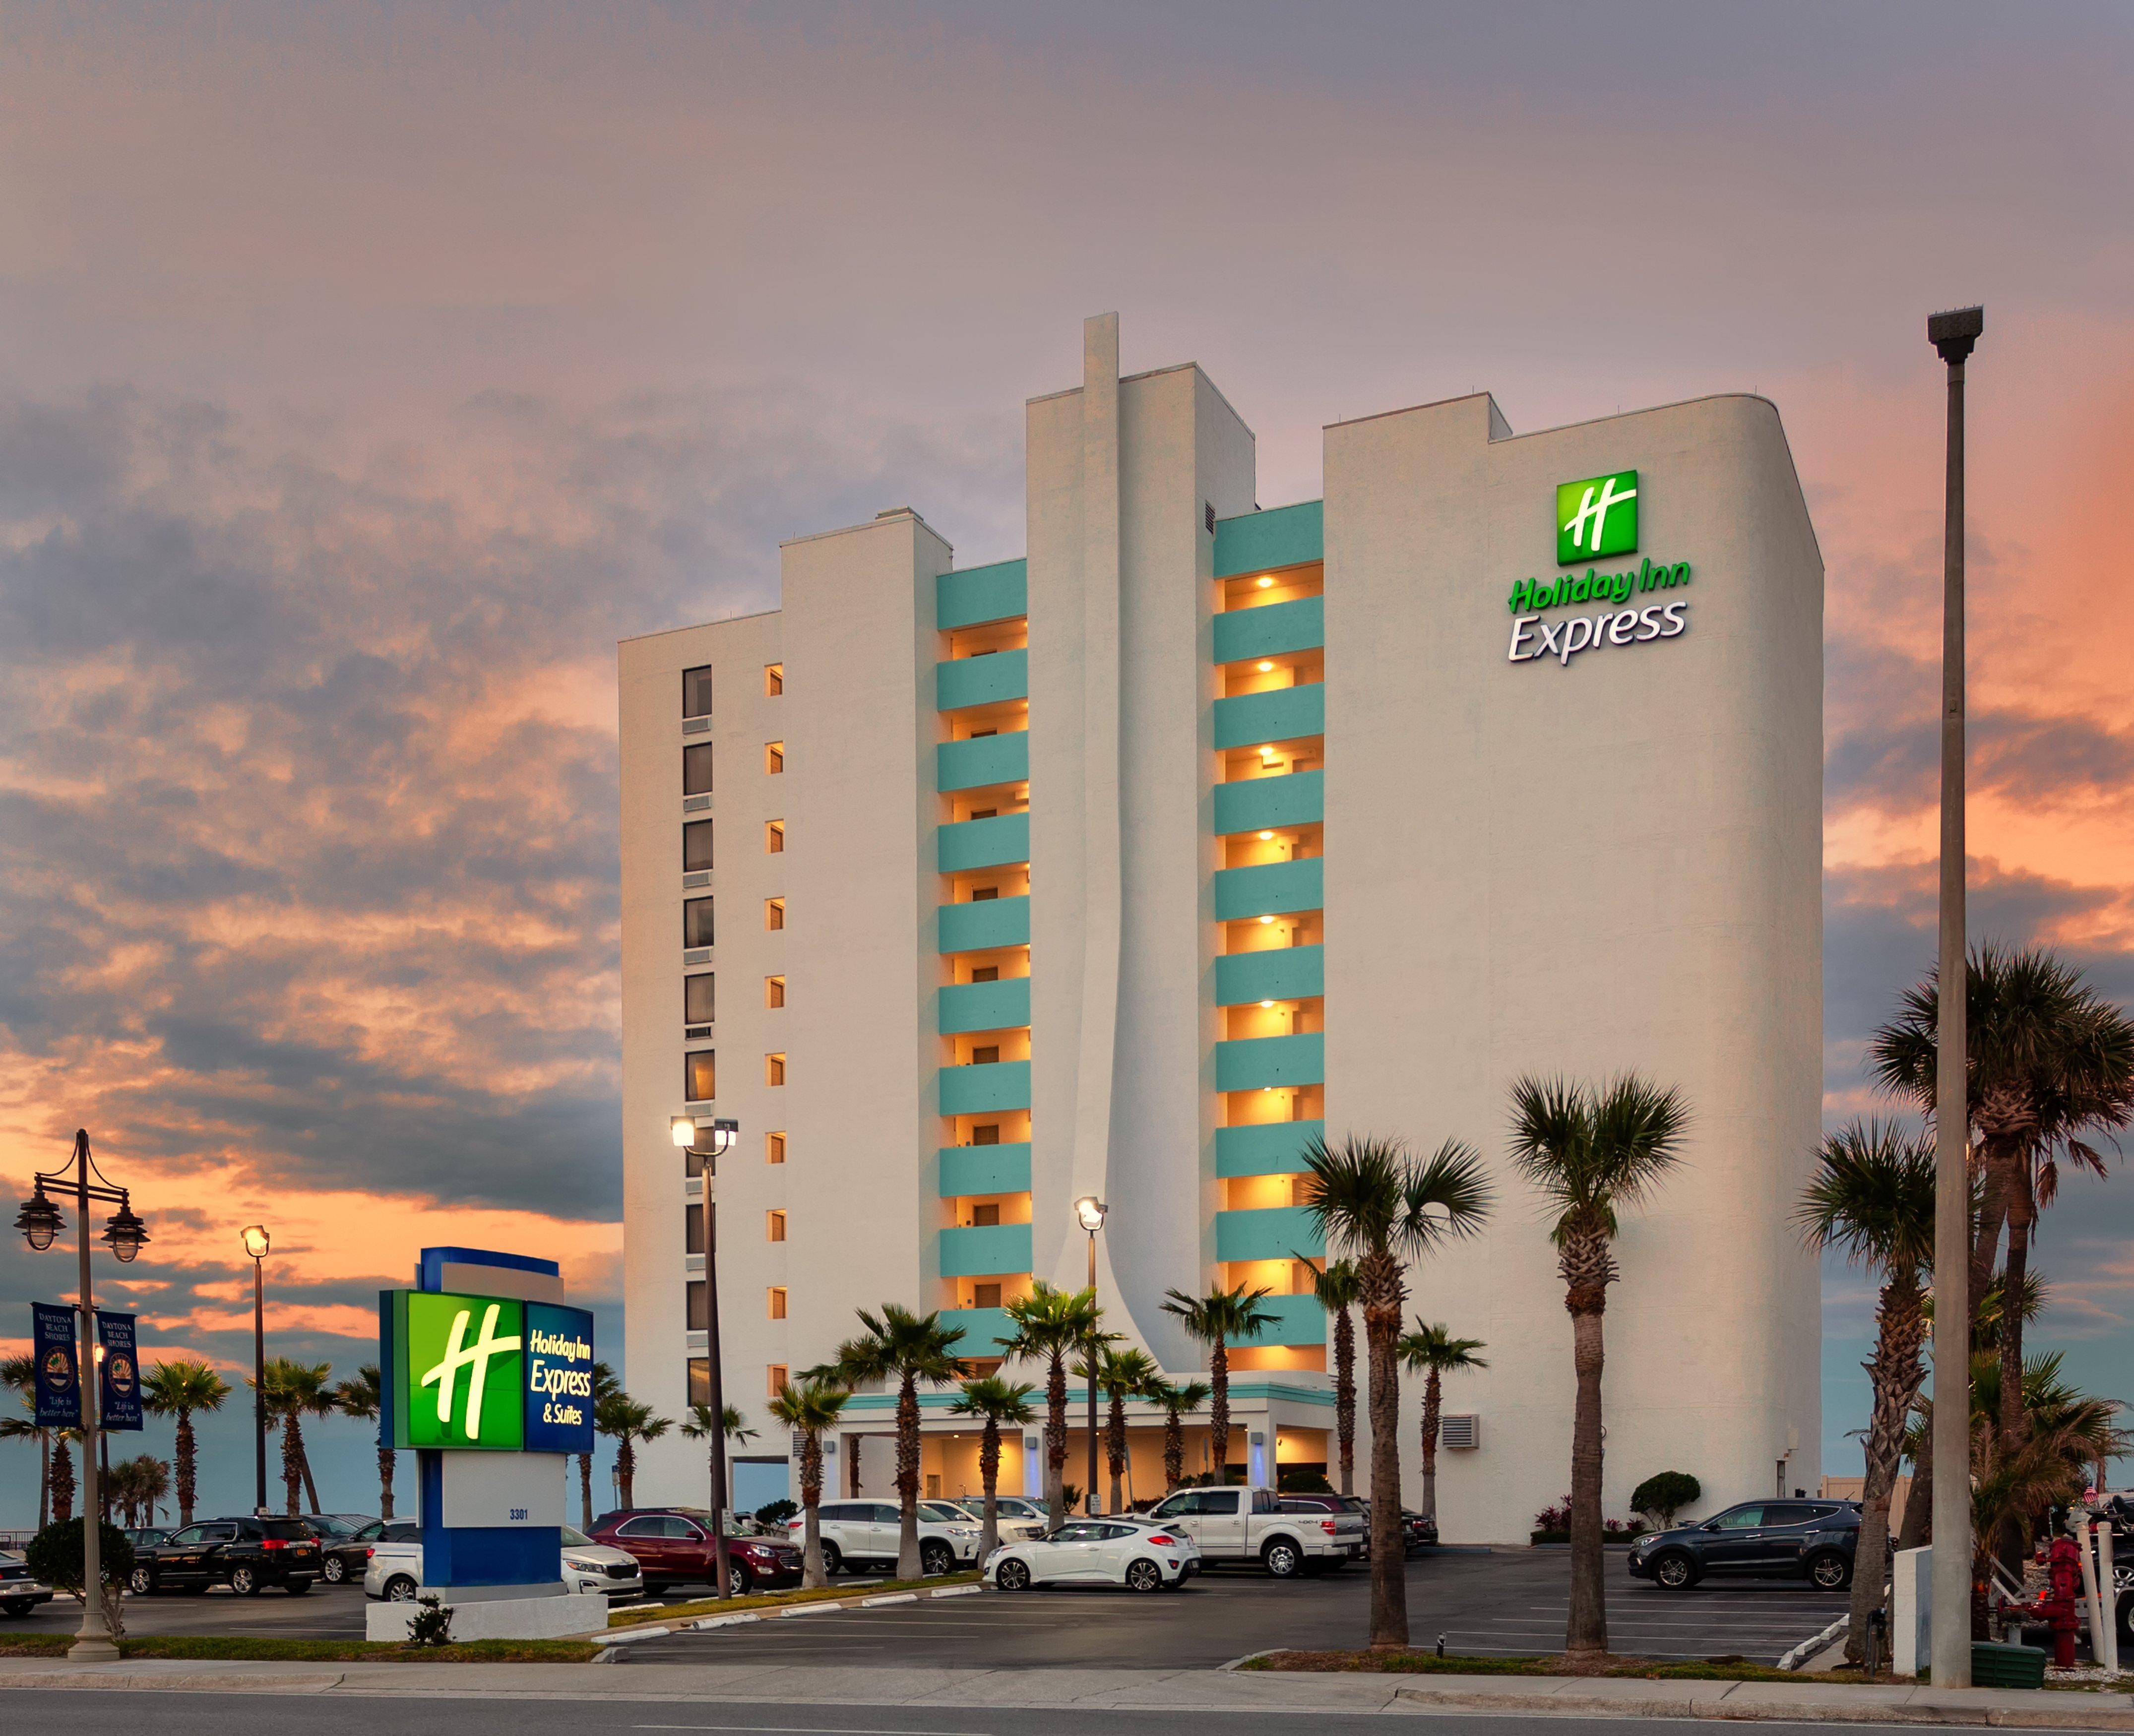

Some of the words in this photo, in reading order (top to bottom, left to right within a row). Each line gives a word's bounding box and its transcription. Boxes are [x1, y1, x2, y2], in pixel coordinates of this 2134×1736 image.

[1508, 568, 1634, 614] Holiday
[1638, 558, 1691, 592] Inn
[1508, 601, 1688, 666] Express
[39, 1312, 71, 1323] DAYTONA
[45, 1323, 68, 1332] BEACH
[102, 1321, 131, 1331] DAYTONA
[45, 1331, 70, 1341] SHORES
[108, 1331, 128, 1339] BEACH
[108, 1339, 131, 1348] SHORES
[530, 1329, 576, 1363] Holiday
[576, 1336, 591, 1361] Inn
[530, 1360, 591, 1402] Express
[66, 1397, 72, 1406] is
[543, 1403, 552, 1423] &
[553, 1403, 582, 1426] Suites
[509, 1508, 528, 1520] 3301
